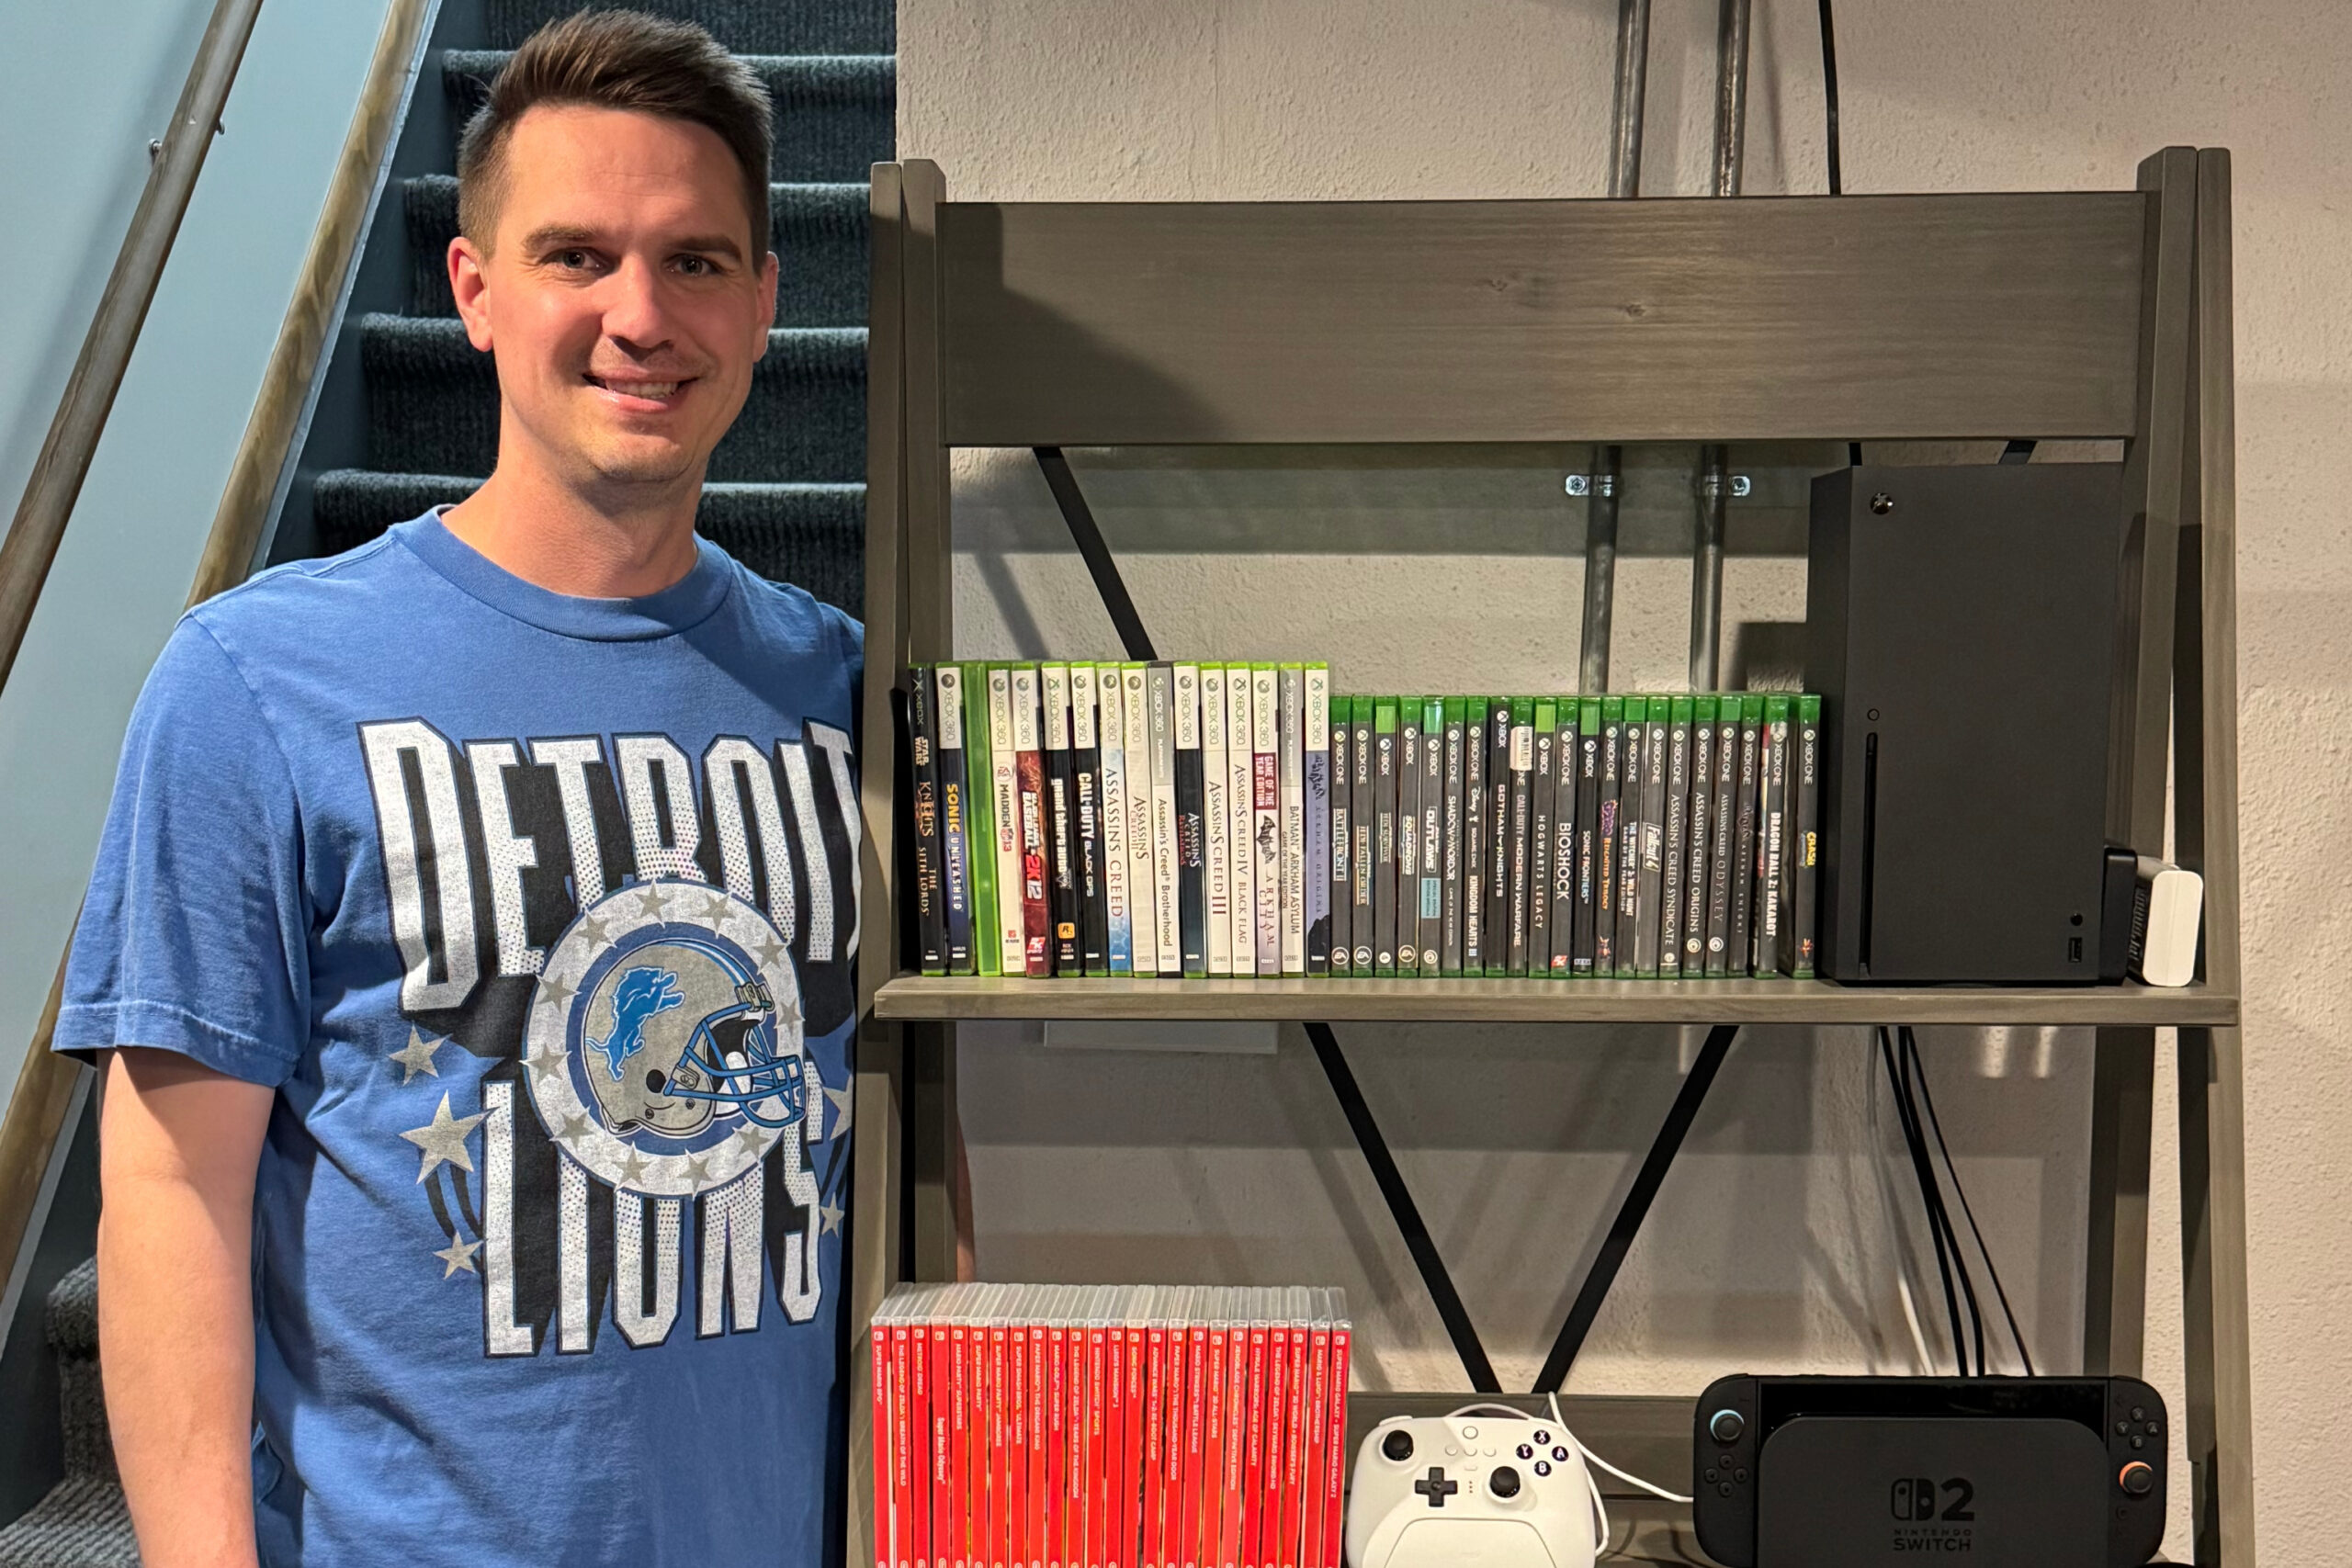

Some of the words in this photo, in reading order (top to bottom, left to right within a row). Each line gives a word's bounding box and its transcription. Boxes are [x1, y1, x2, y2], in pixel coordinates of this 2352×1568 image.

[915, 694, 924, 725] XBOX
[944, 691, 954, 719] XBOX
[1019, 694, 1029, 723] XBOX
[1076, 692, 1085, 720] XBOX
[1105, 692, 1115, 720] XBOX
[1154, 691, 1162, 714] XBOX
[1182, 692, 1191, 720] XBOX
[1208, 694, 1218, 723] XBOX
[1235, 694, 1245, 723] XBOX
[945, 721, 956, 741] 360
[1021, 725, 1030, 744] 360
[1078, 722, 1087, 741] 360
[1107, 722, 1116, 741] 360
[1155, 715, 1164, 732] 360
[1182, 722, 1192, 742] 360
[1209, 725, 1219, 745] 360
[1236, 725, 1246, 745] 360
[1498, 724, 1507, 748] XBOX
[914, 737, 922, 766] WARS
[922, 738, 930, 766] STAR
[1256, 755, 1264, 775] YEAR
[1406, 740, 1414, 764] XBOX
[1429, 752, 1438, 776] XBOX
[1471, 739, 1479, 762] XBOX
[1562, 744, 1570, 766] XBOX
[1773, 744, 1782, 767] XBOX
[1805, 742, 1814, 765] XBOX
[1264, 755, 1273, 777] GAME
[1561, 768, 1569, 786] ONE
[1773, 768, 1781, 786] ONE
[1804, 766, 1813, 785] ONE
[1051, 778, 1065, 810] grand
[1078, 773, 1092, 803] CALL
[1256, 776, 1265, 807] EDITION
[1265, 779, 1274, 790] OF
[1468, 786, 1481, 812] Disney
[920, 782, 933, 837] KNIGHTS
[946, 784, 961, 834] SONIC
[1000, 784, 1011, 829] MADDEN
[1265, 792, 1274, 807] THE
[1497, 784, 1506, 836] GOTHAM
[1516, 795, 1525, 813] CALL
[1022, 792, 1035, 850] BASEBALL
[1056, 813, 1067, 846] theft
[1080, 806, 1094, 840] DUTY
[1158, 798, 1169, 845] Assassin's
[1516, 814, 1525, 835] DUTY
[1629, 821, 1637, 835] THE
[1770, 812, 1781, 852] DRAGON
[1002, 840, 1012, 852] 13
[1238, 819, 1247, 858] CREED
[1335, 808, 1346, 873] BATTLEFRONT
[1405, 815, 1413, 875] SQUADRONS
[1425, 810, 1436, 870] OUTLAWS
[1536, 815, 1545, 879] HOGWARTS
[1582, 830, 1591, 855] SONIC
[1646, 825, 1661, 861] Fallout
[1806, 831, 1816, 866] CRASH
[356, 716, 861, 1010] DETROIT
[919, 847, 927, 873] SITH
[1057, 847, 1068, 873] auto
[1084, 840, 1093, 874] BLACK
[1214, 847, 1223, 893] CREED
[1238, 860, 1248, 875] IV
[1496, 846, 1505, 897] KNIGHTS
[1515, 837, 1524, 891] MODERN
[1556, 822, 1572, 900] BIOSHOCK
[1645, 860, 1657, 869] 4
[1668, 851, 1678, 886] CREED
[1692, 848, 1702, 884] CREED
[1769, 852, 1779, 877] BALL
[929, 868, 937, 889] THE
[950, 837, 963, 910] UNLEASHED
[1026, 855, 1042, 899] 2K12
[1086, 876, 1094, 897] OPS
[1290, 852, 1300, 895] ARKHAM
[1768, 879, 1778, 888] Z:
[920, 876, 929, 913] LORDS
[1110, 860, 1123, 917] CREED
[1238, 882, 1247, 915] BLACK
[1468, 875, 1478, 914] KINGDOM
[1601, 878, 1611, 909] TRILOGY
[1714, 860, 1725, 922] ODYSSEY
[1161, 885, 1172, 947] Brotherhood
[1212, 896, 1227, 915] III
[1259, 889, 1267, 931] CITY
[1265, 870, 1275, 946] ARKHAM
[1290, 897, 1300, 934] ASYLUM
[1514, 892, 1522, 948] WARFARE
[1535, 886, 1544, 929] LEGACY
[1665, 887, 1678, 946] SYNDICATE
[1690, 886, 1701, 932] ORIGINS
[1766, 891, 1778, 936] KAKAROT
[1238, 918, 1247, 943] FLAG
[1468, 916, 1477, 947] HEARTS
[482, 1062, 826, 1358] LIONS
[936, 1417, 944, 1435] Super
[1538, 1431, 1546, 1441] X
[1521, 1445, 1529, 1457] Y
[1556, 1448, 1565, 1459] A
[1539, 1461, 1547, 1473] B
[1940, 1477, 1974, 1521] 2
[1894, 1529, 1972, 1537] NINTENDO
[1894, 1538, 1972, 1551] SWITCH
